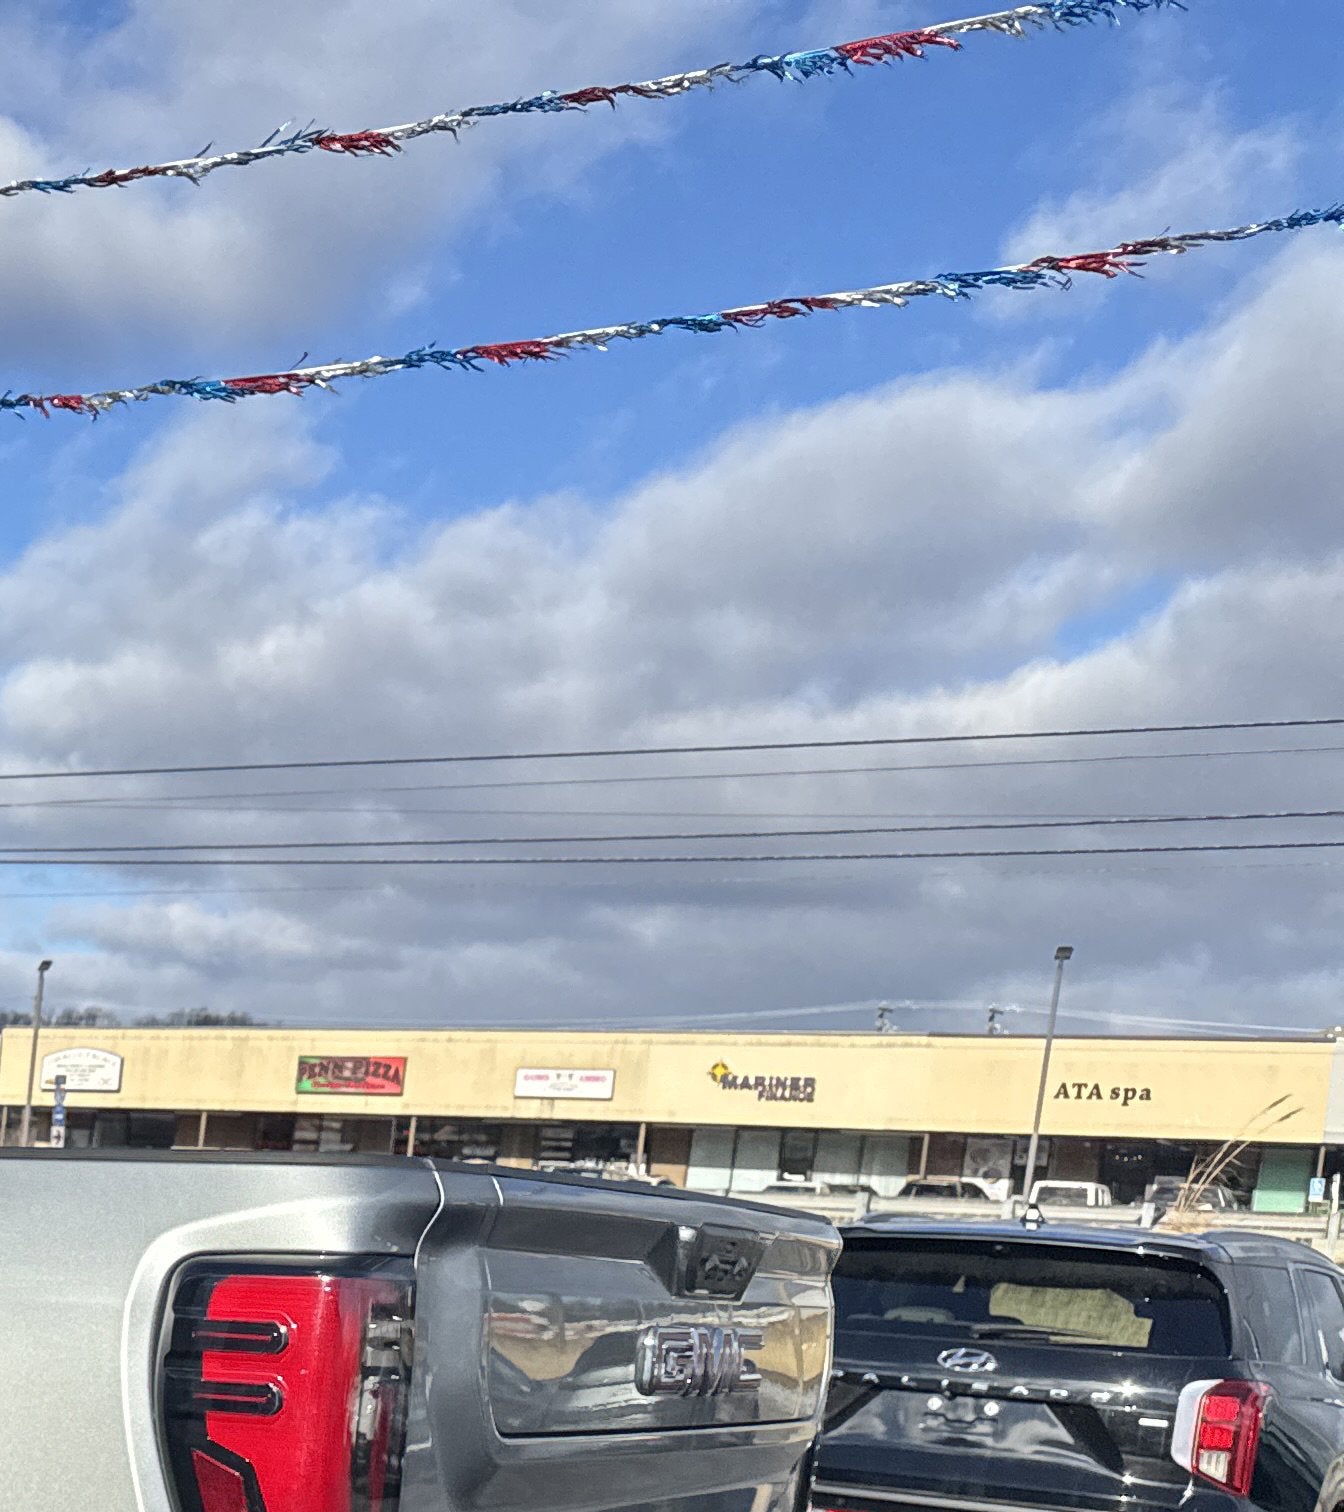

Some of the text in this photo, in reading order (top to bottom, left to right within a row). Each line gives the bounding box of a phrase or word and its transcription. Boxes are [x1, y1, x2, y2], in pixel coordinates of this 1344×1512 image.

[352, 1060, 402, 1085] PIZZA
[720, 1075, 816, 1090] MARINER
[1053, 1082, 1152, 1107] ATA spa
[638, 1325, 765, 1396] GMC
